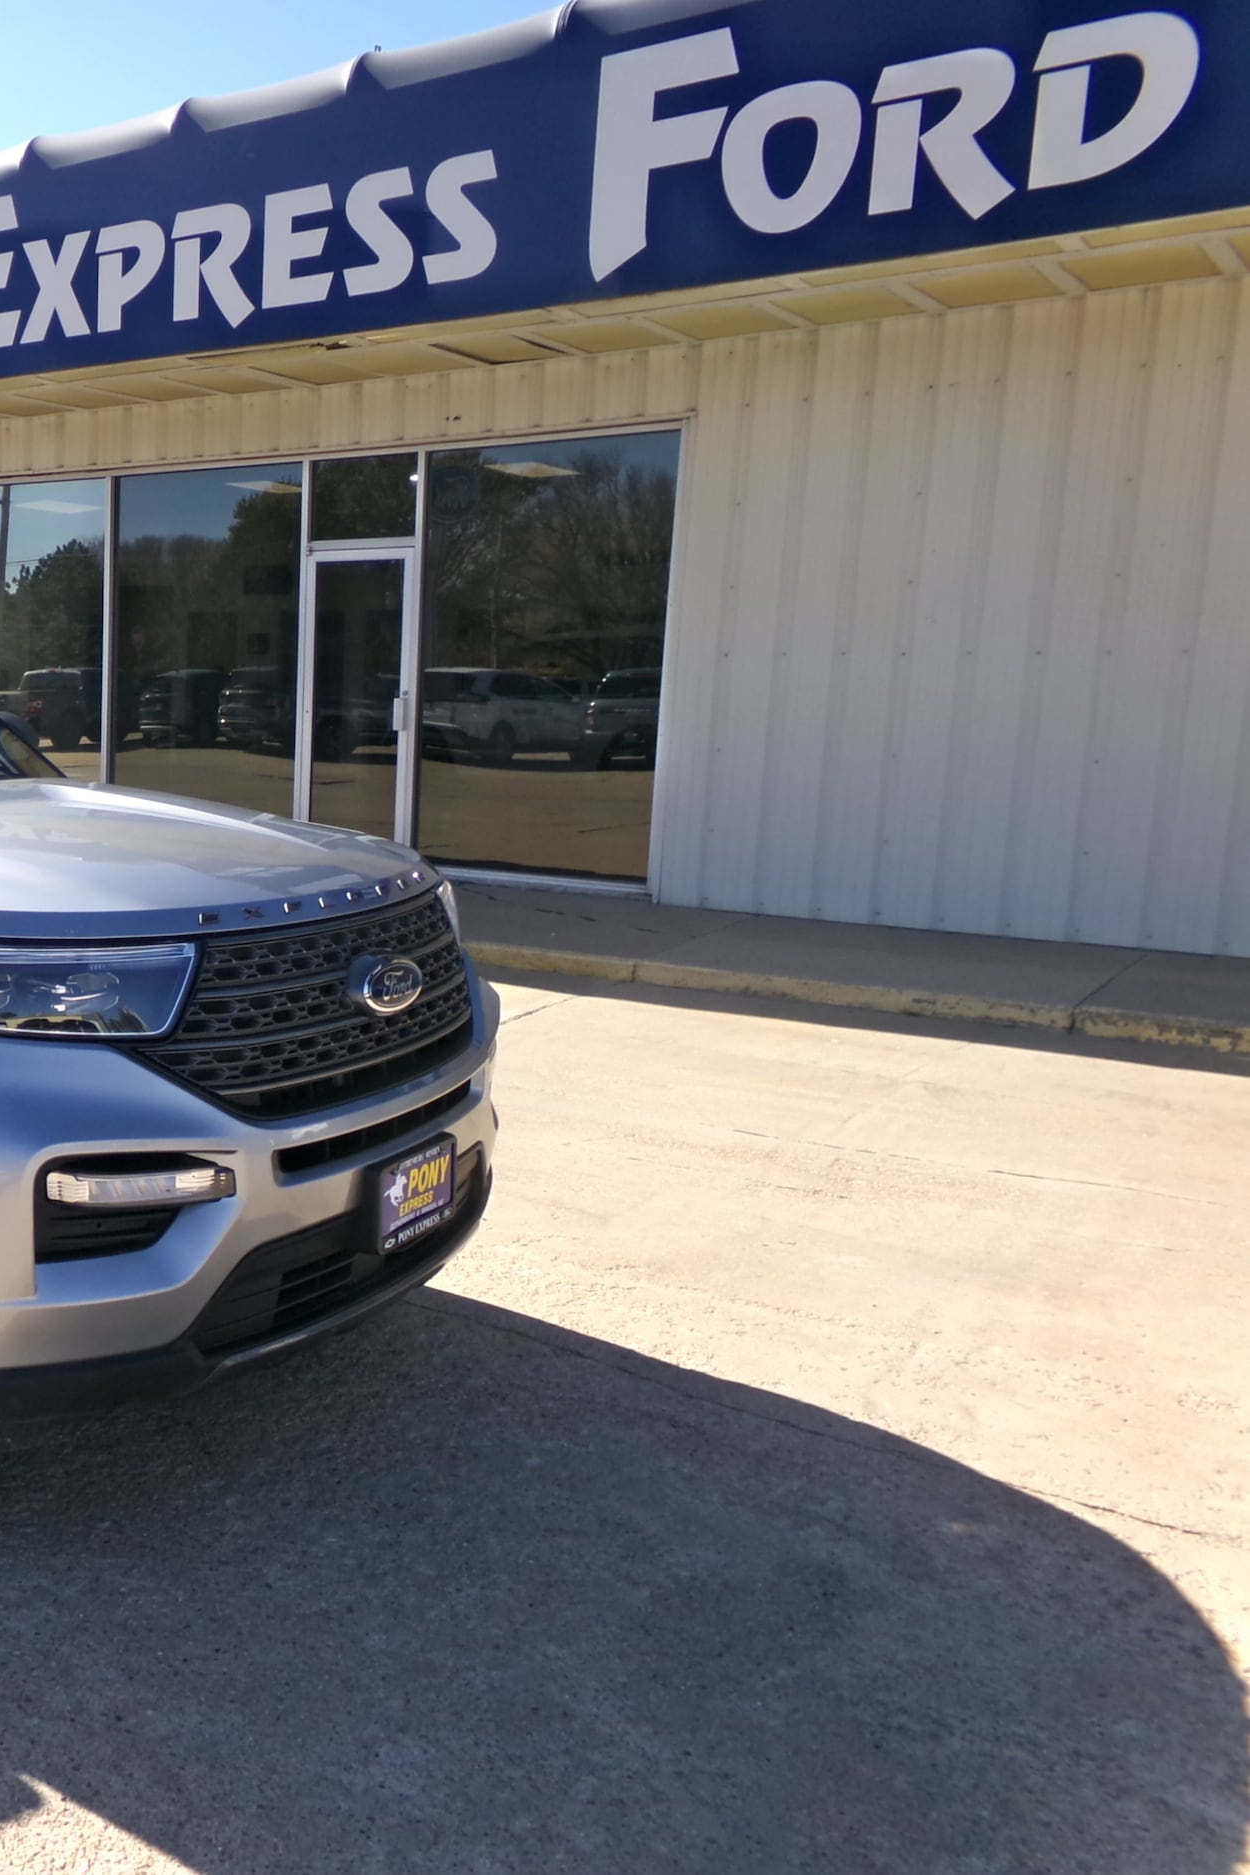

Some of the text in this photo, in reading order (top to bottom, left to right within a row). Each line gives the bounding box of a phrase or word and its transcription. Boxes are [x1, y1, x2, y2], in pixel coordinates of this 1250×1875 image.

[588, 11, 1200, 283] FORD
[382, 968, 415, 1002] Ford
[407, 1154, 450, 1198] PONY
[399, 1190, 434, 1217] EXPRESS
